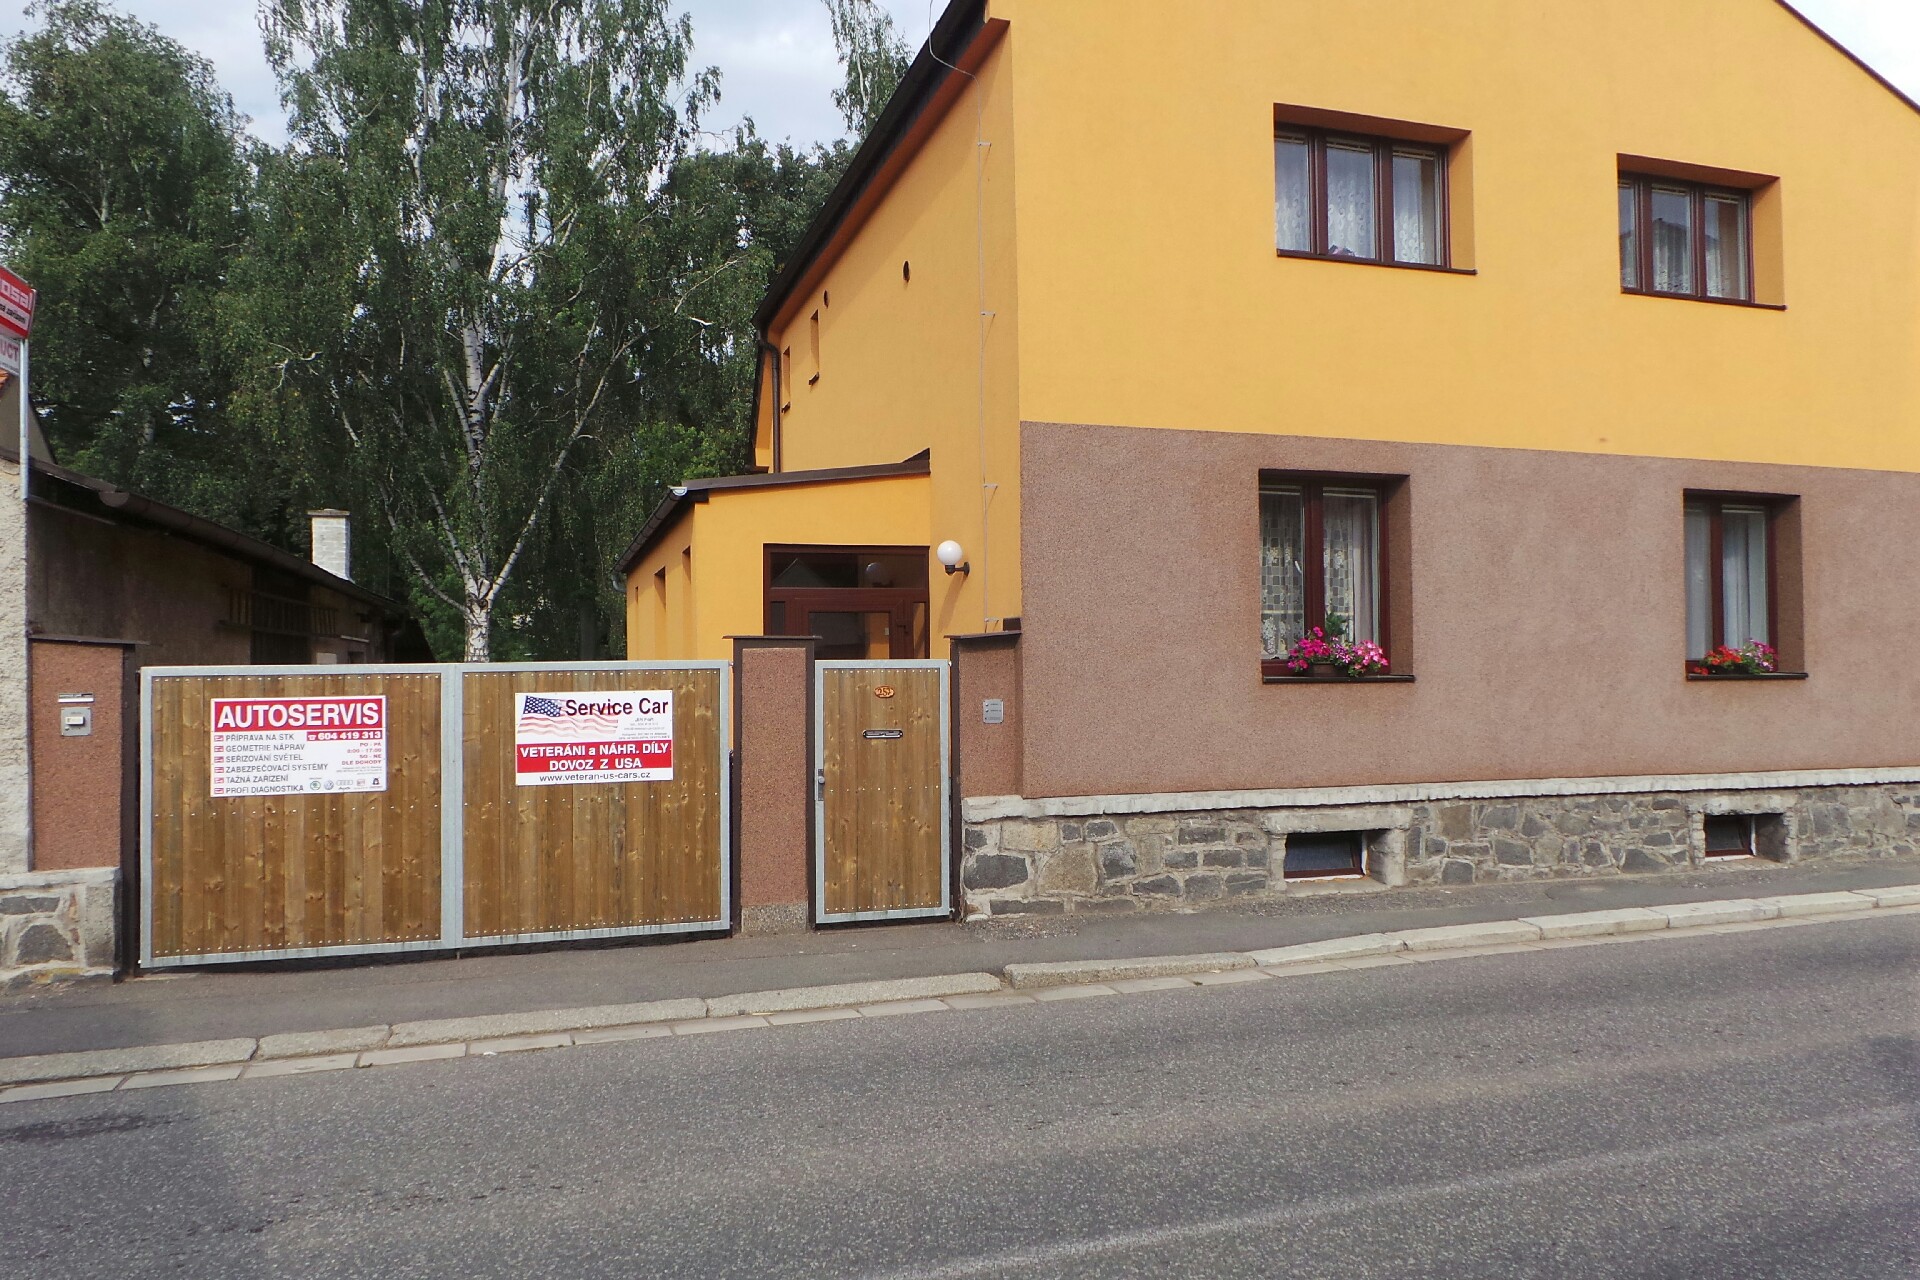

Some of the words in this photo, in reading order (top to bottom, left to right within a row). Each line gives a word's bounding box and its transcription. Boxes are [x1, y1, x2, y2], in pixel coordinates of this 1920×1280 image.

[565, 698, 633, 717] Service
[639, 697, 669, 715] Car
[217, 702, 379, 728] AUTOSERVIS
[226, 733, 264, 742] PŘÍPRAVA
[279, 733, 295, 741] STK
[318, 732, 338, 740] 604
[340, 731, 360, 739] 419
[362, 730, 381, 739] 313
[226, 744, 271, 753] GEOMETRIE
[273, 742, 305, 751] NÁPRAV
[520, 744, 586, 758] VETERÁNI
[588, 747, 596, 756] a
[599, 743, 640, 756] NÁHR.
[642, 741, 669, 754] DÍLY
[273, 752, 304, 761] SVĚTEL
[226, 764, 290, 774] ZABEZPEČOVACÍ
[549, 759, 594, 771] DOVOZ
[599, 758, 609, 769] Z
[615, 757, 643, 768] USA
[540, 771, 651, 782] www.veteran-us-cars.cz
[251, 784, 304, 793] DIAGNOSTIKA
